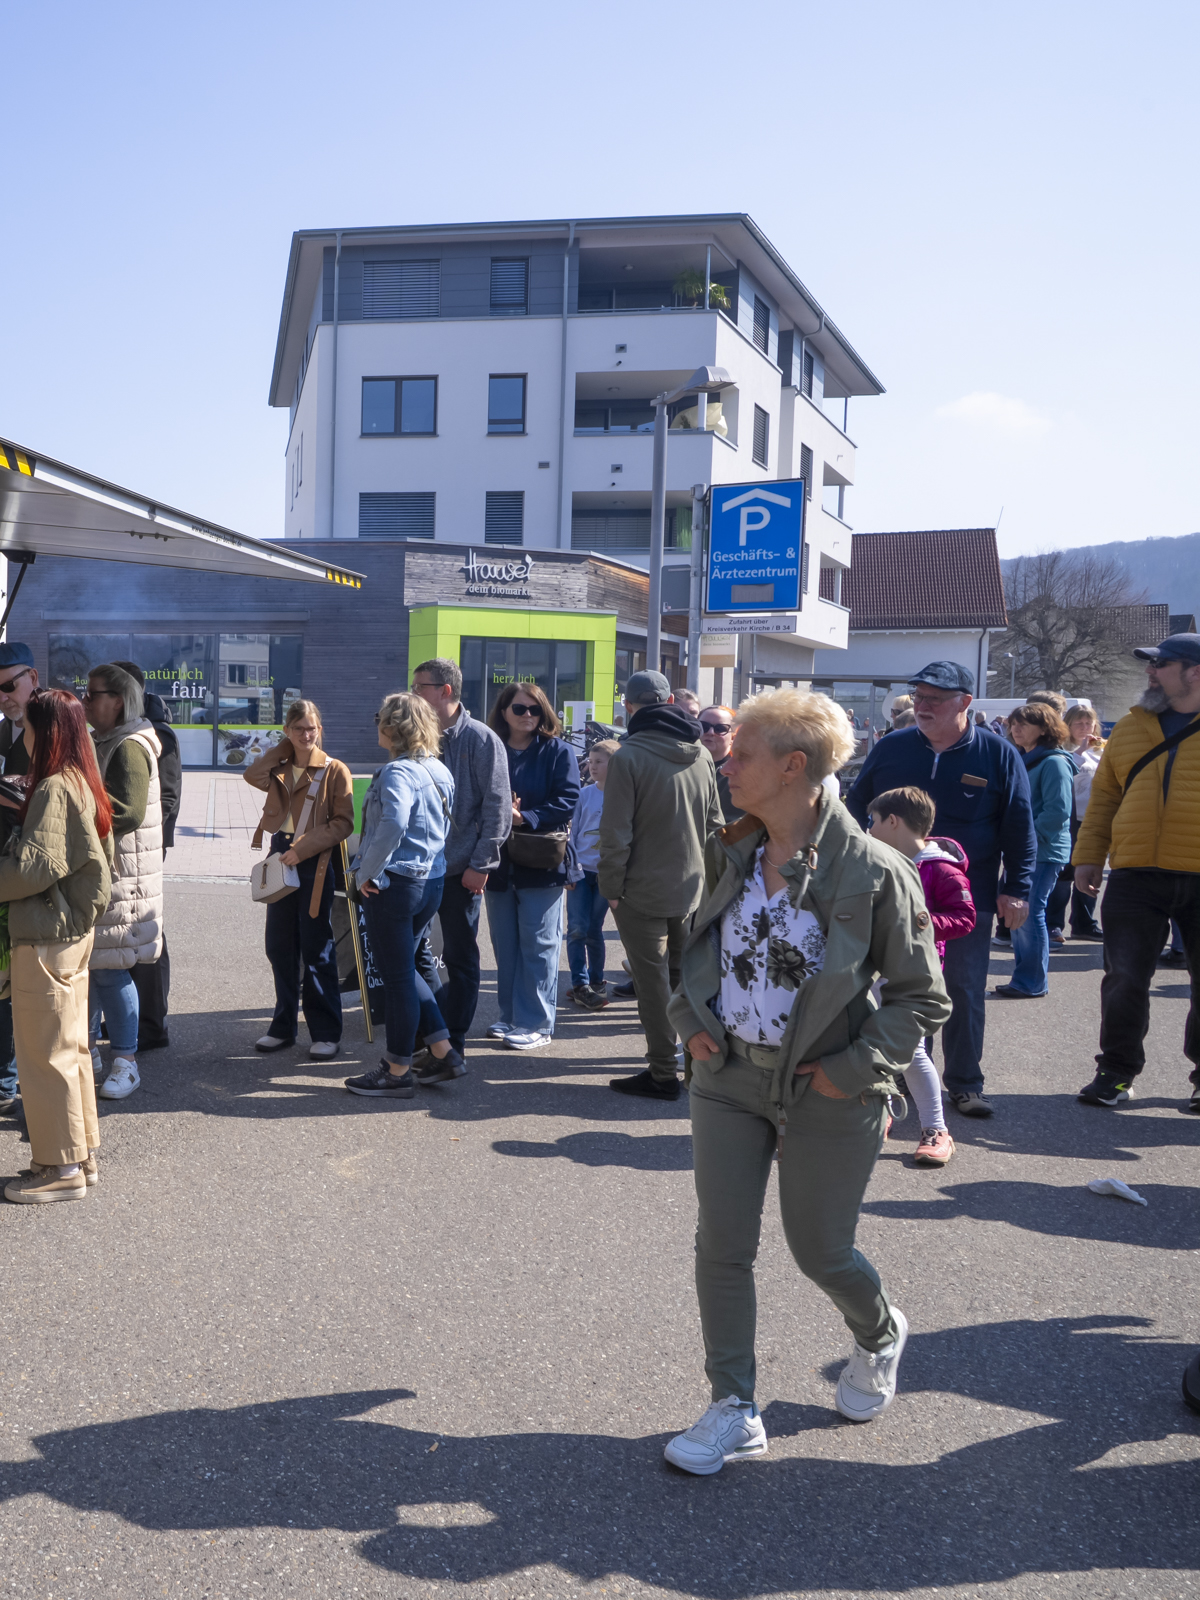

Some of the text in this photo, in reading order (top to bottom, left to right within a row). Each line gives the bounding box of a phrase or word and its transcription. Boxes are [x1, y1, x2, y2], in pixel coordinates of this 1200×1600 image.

[739, 505, 771, 547] P
[712, 547, 796, 563] Geschäfts- &
[462, 547, 536, 582] Hauser
[711, 565, 797, 580] Ärztezentrum
[469, 584, 489, 594] dein
[141, 667, 204, 680] natürlich
[493, 672, 536, 684] herz lich
[171, 680, 207, 699] fair
